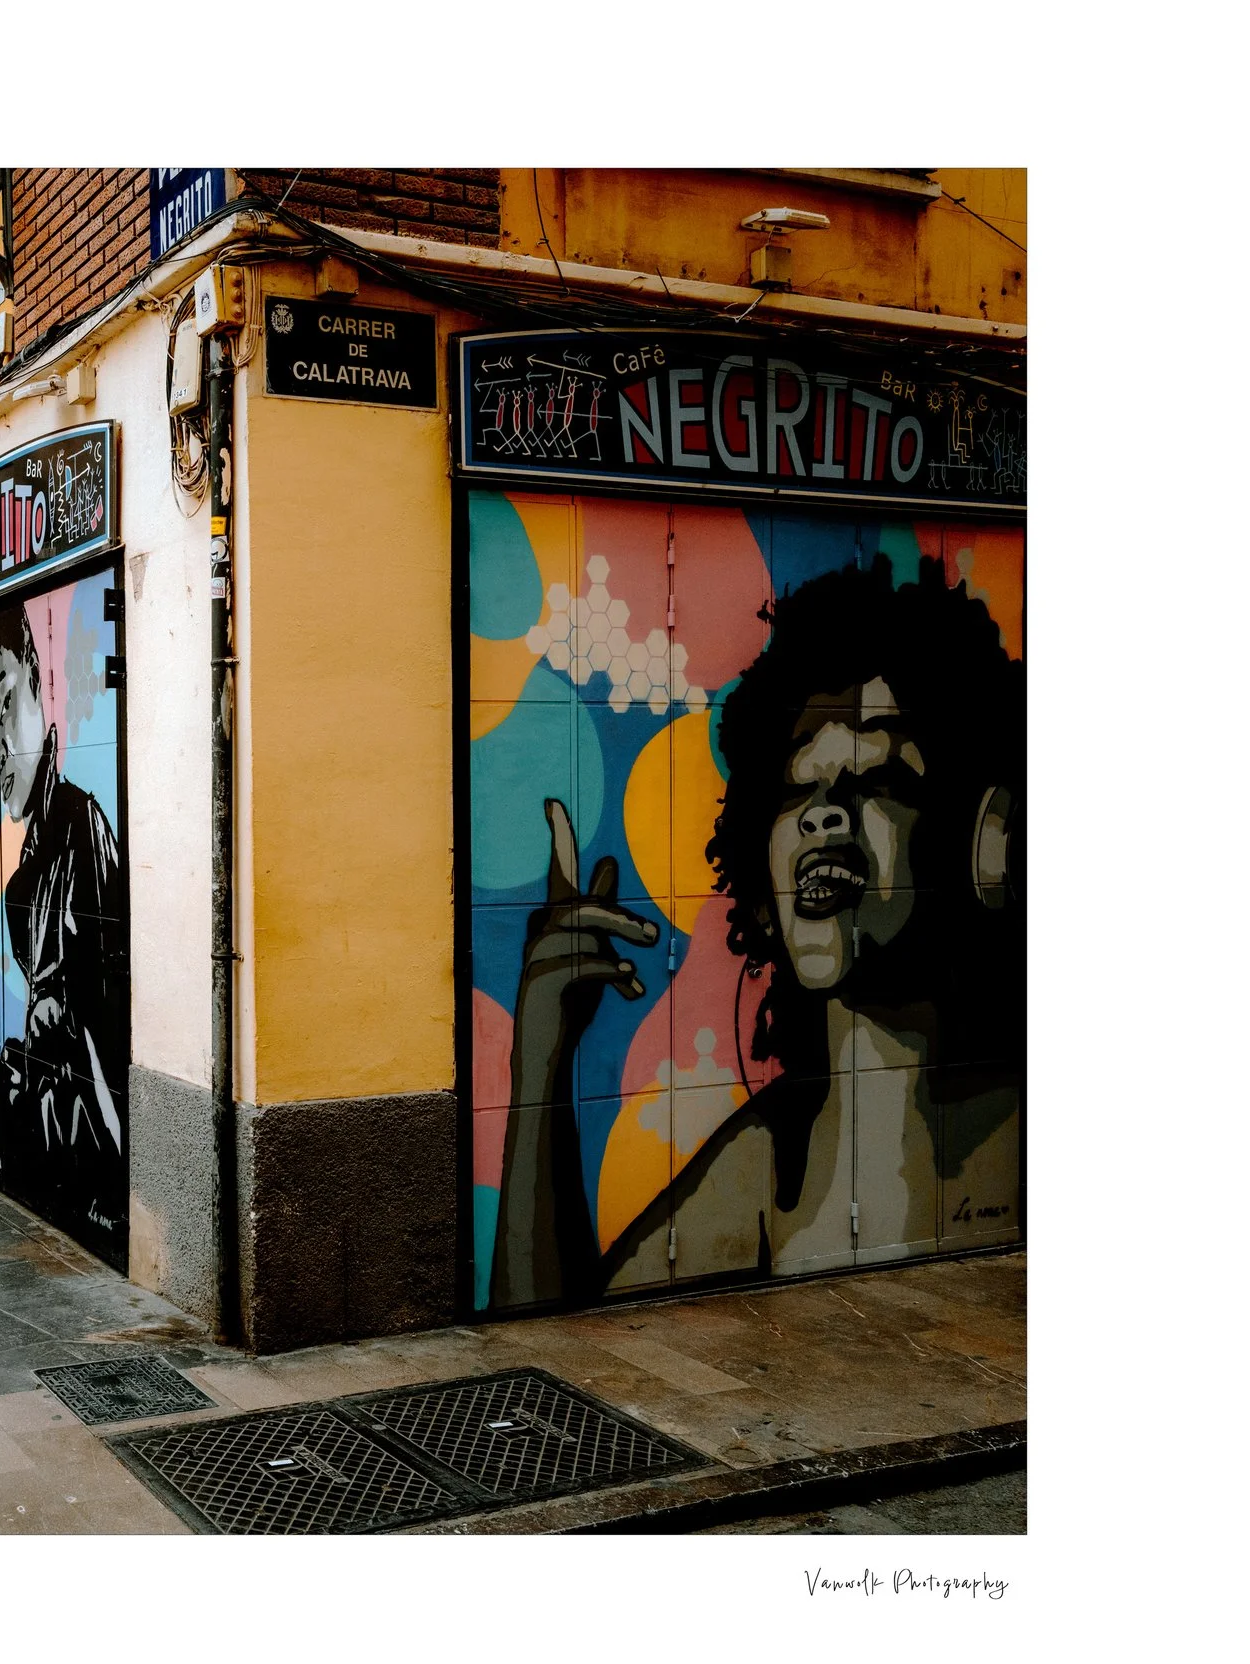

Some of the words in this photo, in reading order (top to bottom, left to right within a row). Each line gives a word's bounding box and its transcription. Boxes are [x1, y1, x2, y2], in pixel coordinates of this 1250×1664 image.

[159, 170, 212, 255] NEGRITO
[318, 315, 396, 339] CARRER
[349, 343, 368, 358] DE
[292, 361, 412, 390] CALATRAVA
[618, 355, 925, 483] NEGRITO
